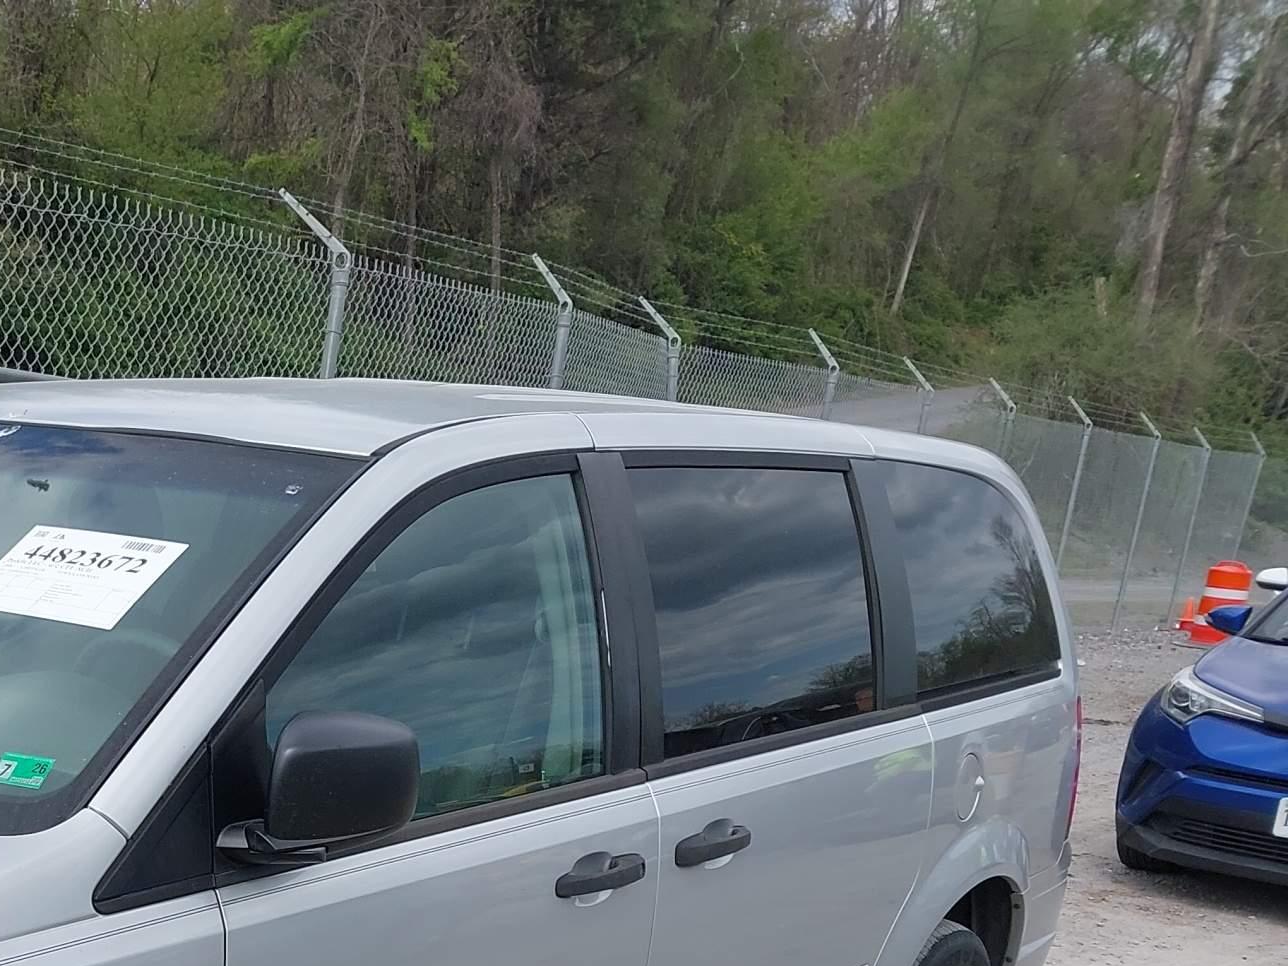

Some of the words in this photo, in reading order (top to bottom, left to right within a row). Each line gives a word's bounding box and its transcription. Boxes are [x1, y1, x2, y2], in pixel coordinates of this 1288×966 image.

[24, 544, 148, 574] 44823672
[0, 763, 13, 776] 7
[31, 762, 49, 775] 26
